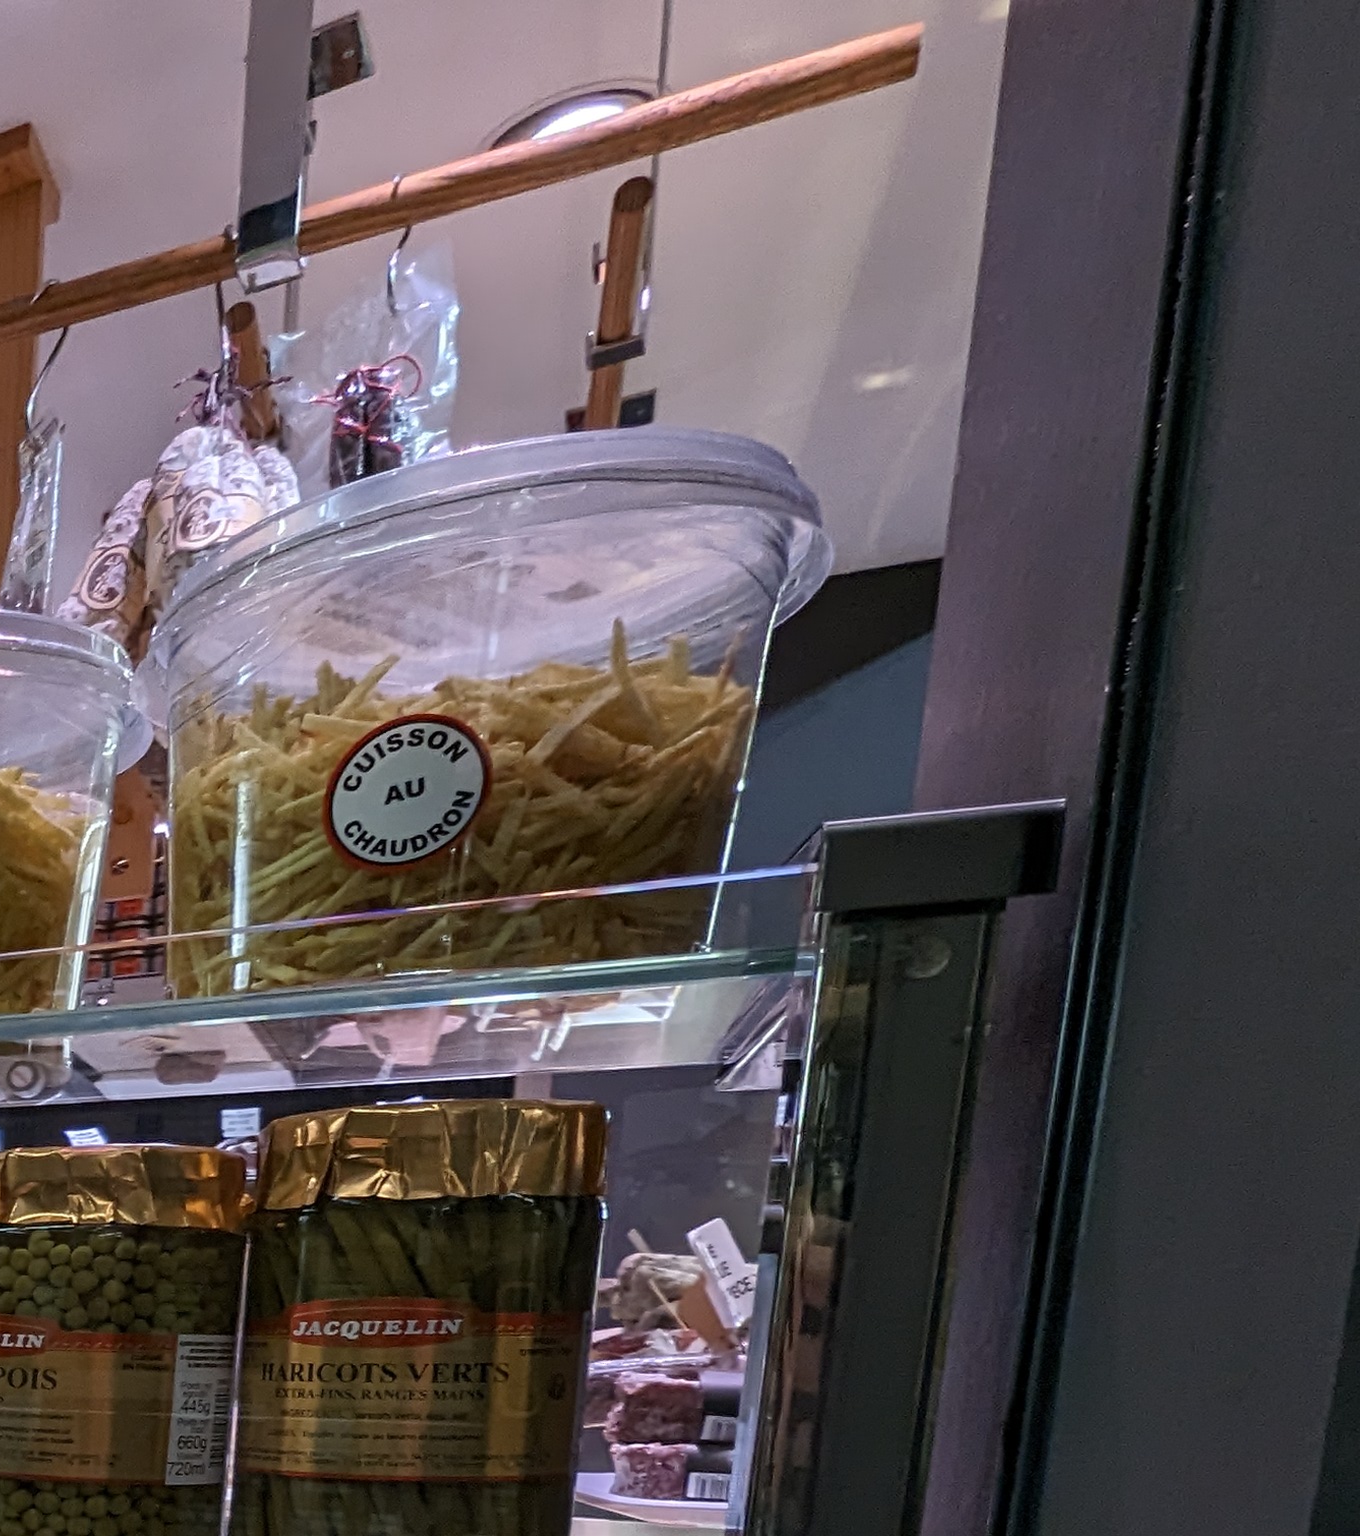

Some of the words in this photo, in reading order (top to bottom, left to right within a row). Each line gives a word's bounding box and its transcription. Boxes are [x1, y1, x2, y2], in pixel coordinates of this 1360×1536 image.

[343, 728, 469, 791] CUISSON
[385, 777, 424, 805] AU
[344, 790, 475, 856] CHAUDRON
[292, 1318, 464, 1340] JACQUELIN
[261, 1362, 397, 1383] HARICOTS
[406, 1362, 510, 1383] VERTS
